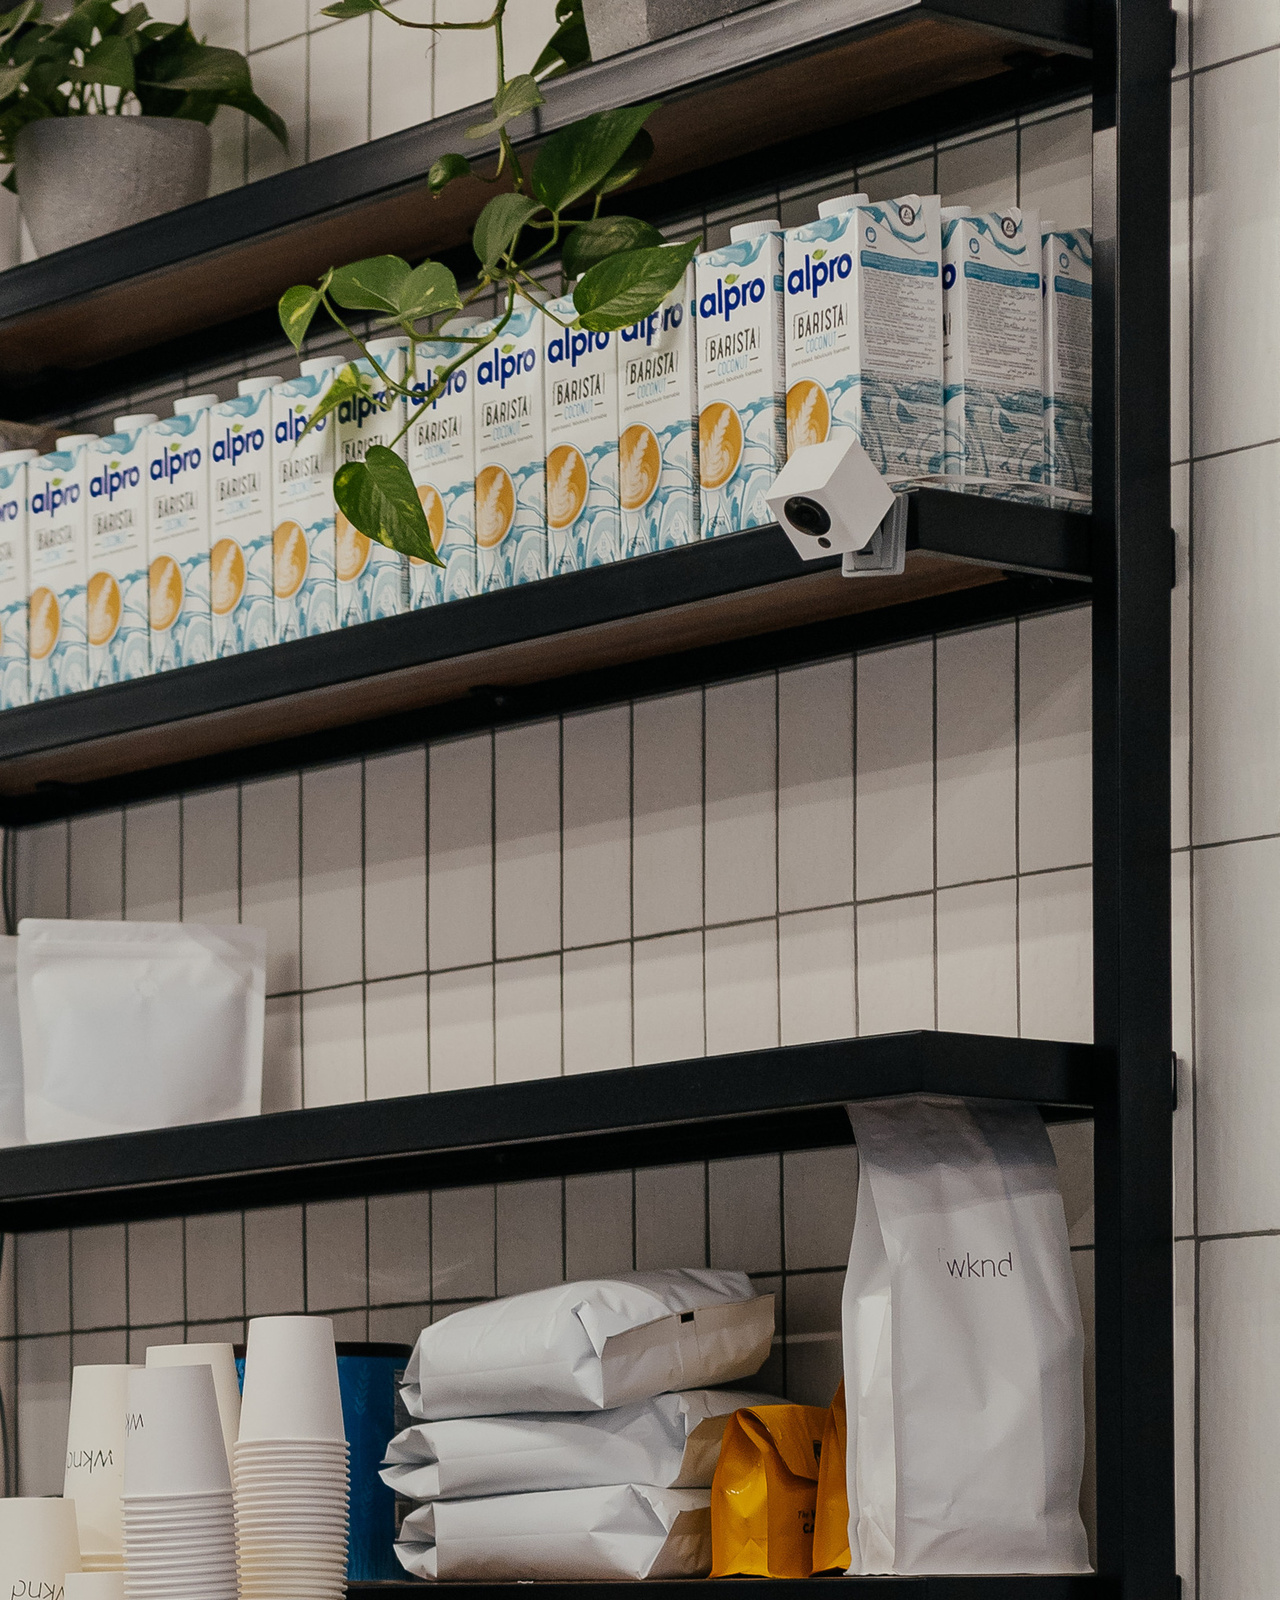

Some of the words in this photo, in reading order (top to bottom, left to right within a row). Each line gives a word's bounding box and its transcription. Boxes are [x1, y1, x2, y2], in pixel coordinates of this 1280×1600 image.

[787, 253, 852, 298] alpro
[700, 277, 765, 322] alpro
[798, 304, 844, 339] BARISTA
[548, 327, 610, 368] alpro
[710, 327, 756, 362] BARISTA
[805, 331, 837, 354] COCONUT
[477, 347, 536, 389] alpro
[630, 351, 674, 385] BARISTA
[717, 355, 748, 377] COCONUT
[557, 373, 601, 405] BARISTA
[637, 378, 666, 400] COCONUT
[275, 408, 326, 447] alpo
[486, 395, 528, 426] BARISTA
[212, 428, 264, 466] alpro
[418, 416, 458, 446] BARISTA
[150, 446, 201, 484] alpro
[31, 481, 80, 518] alpro
[89, 464, 140, 502] alpro
[946, 1252, 1013, 1278] wknd
